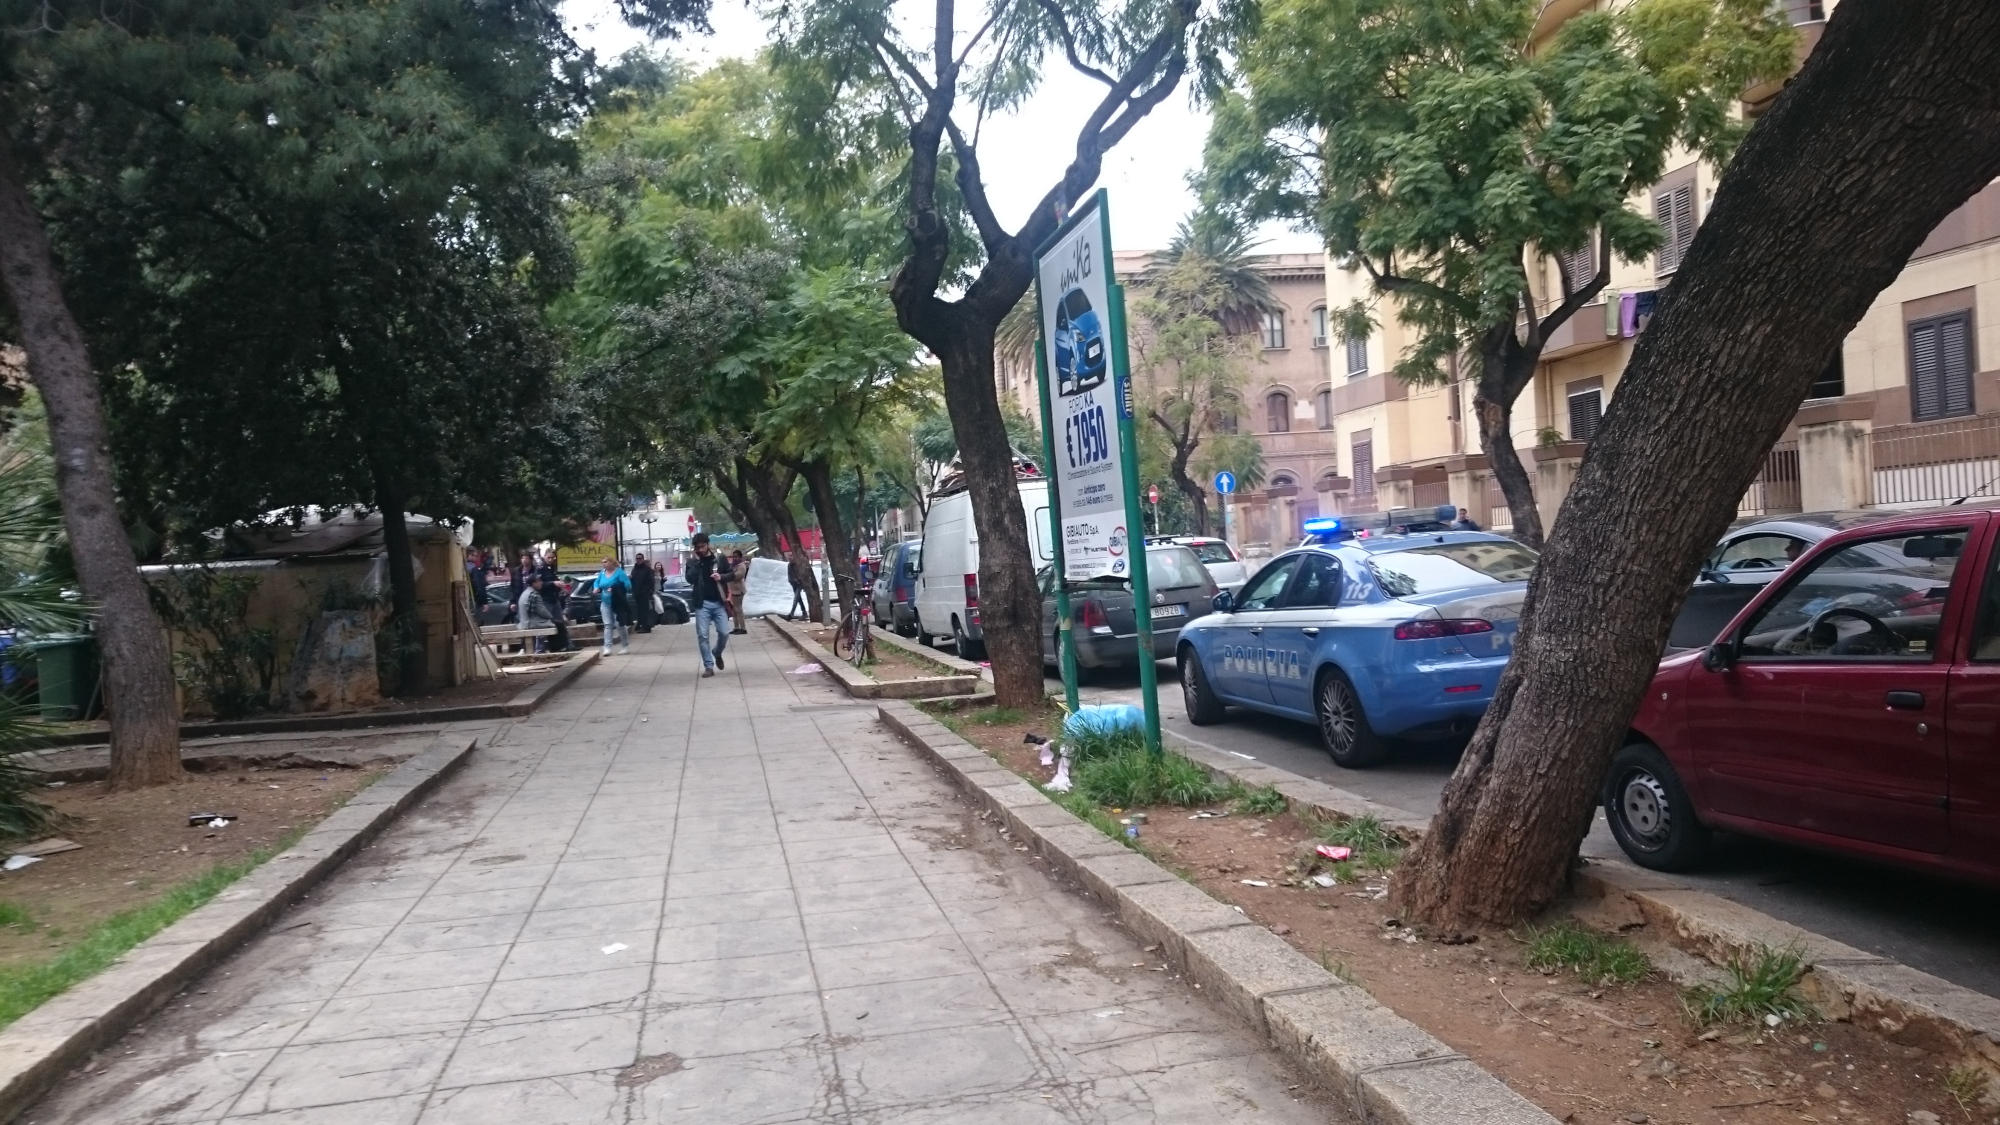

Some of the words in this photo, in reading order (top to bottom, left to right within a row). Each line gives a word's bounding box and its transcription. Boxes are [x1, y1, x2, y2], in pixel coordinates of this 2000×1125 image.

[1069, 396, 1083, 414] FORD
[1084, 391, 1094, 408] KA
[1066, 417, 1076, 468] €
[1345, 582, 1374, 600] 113
[1224, 644, 1302, 680] POLIZIA
